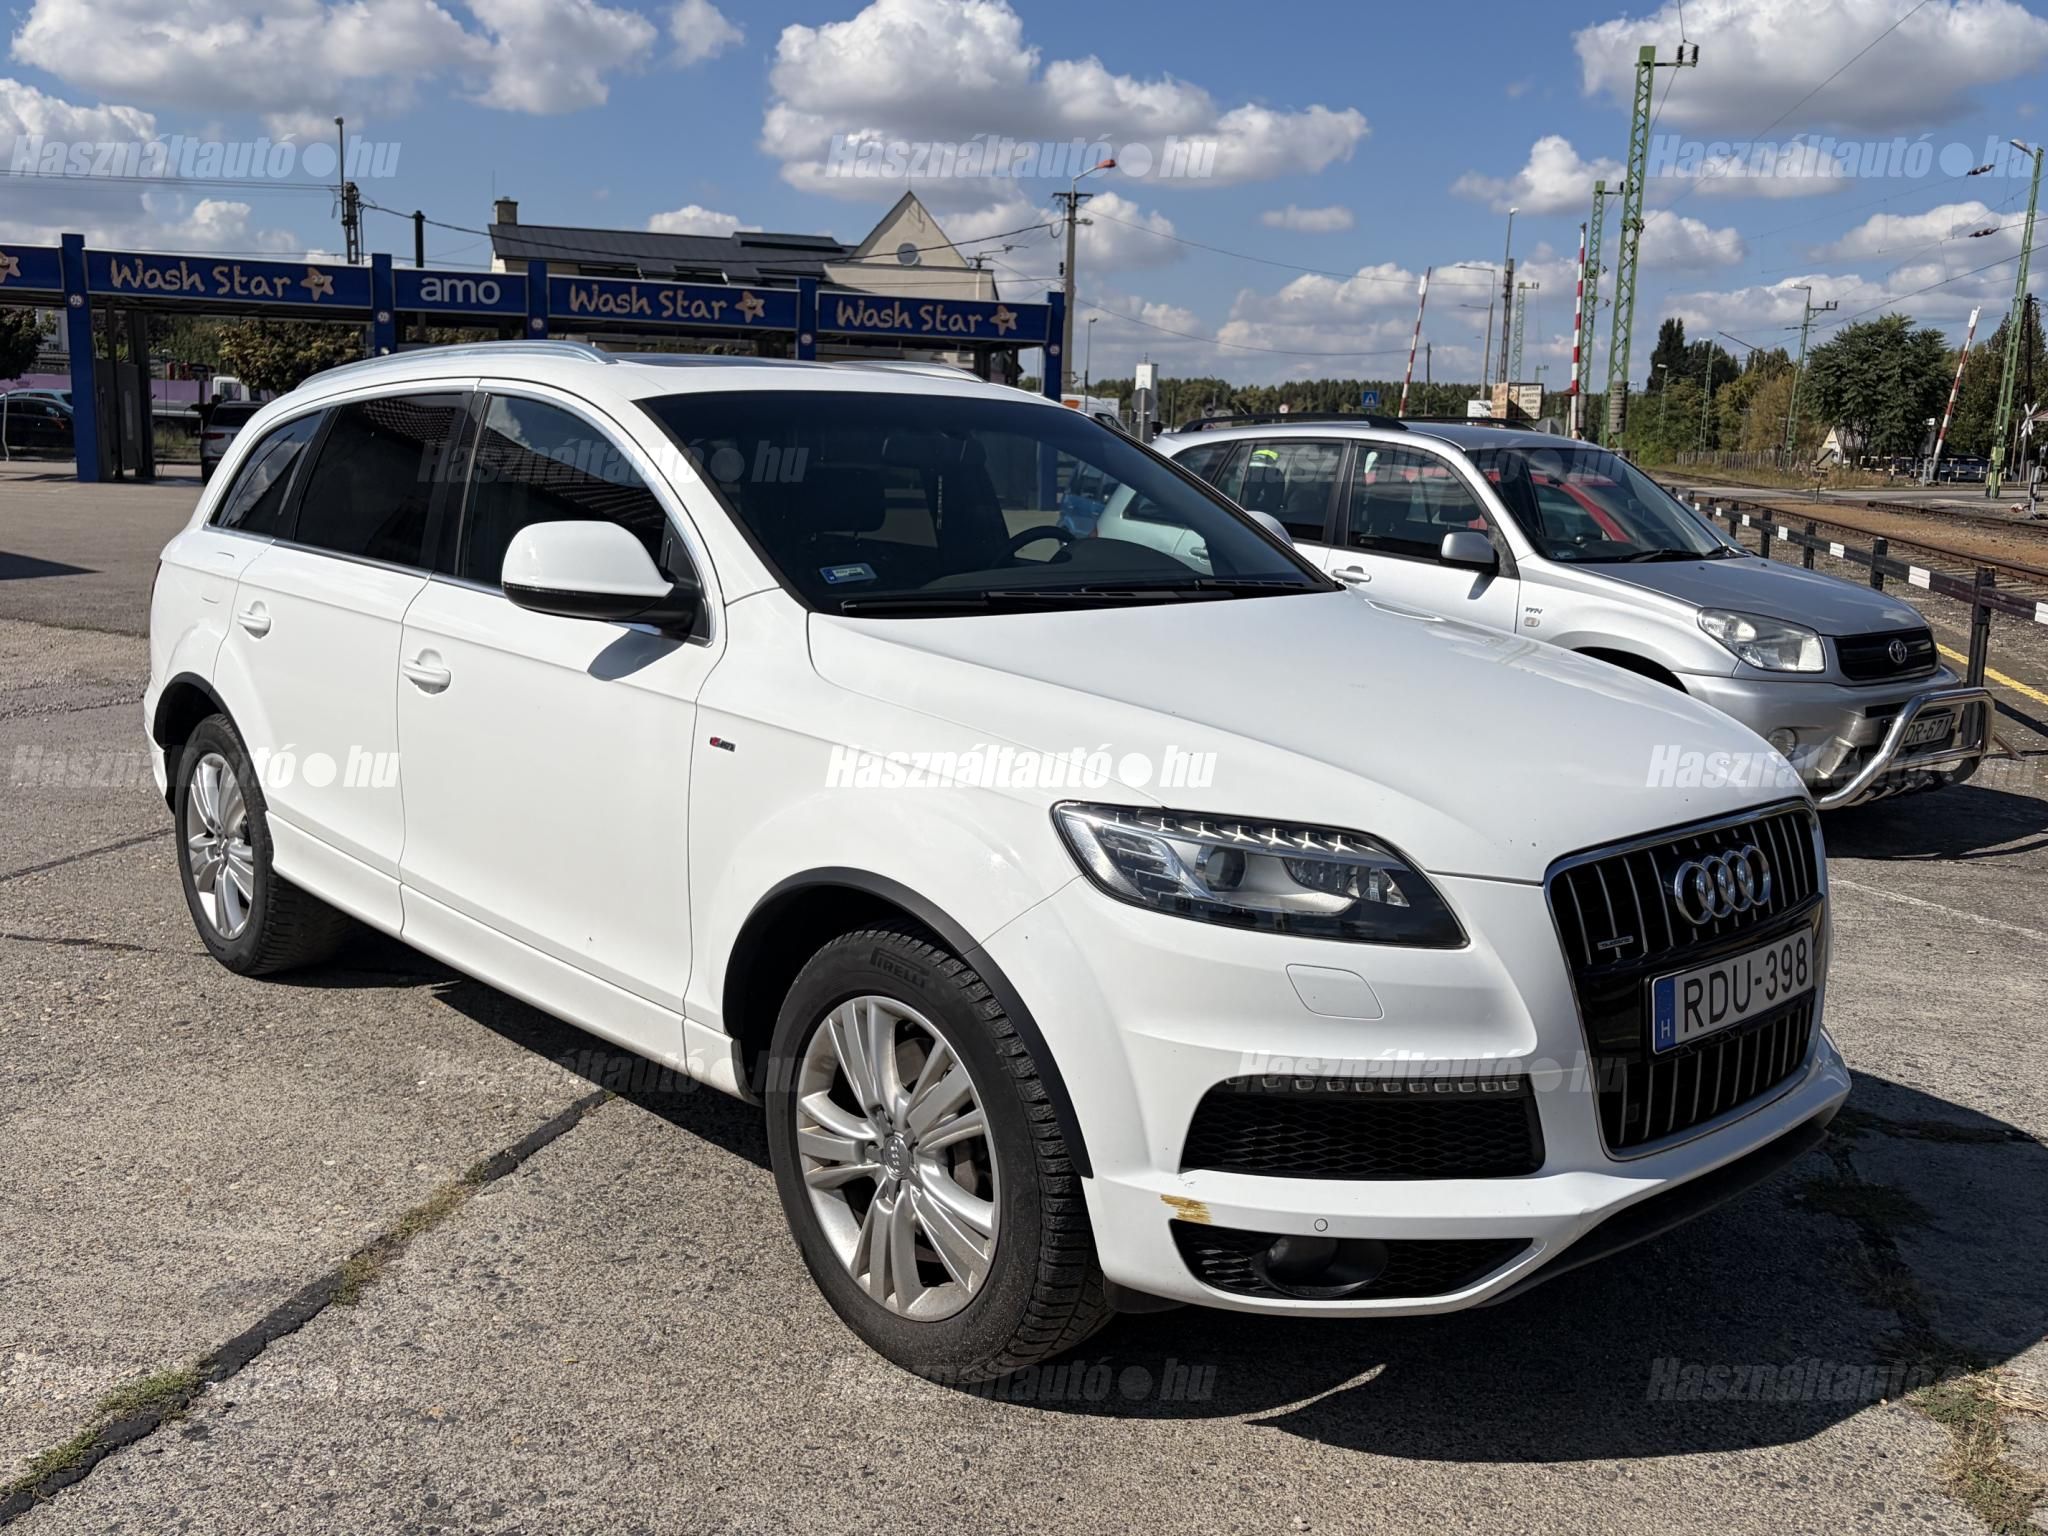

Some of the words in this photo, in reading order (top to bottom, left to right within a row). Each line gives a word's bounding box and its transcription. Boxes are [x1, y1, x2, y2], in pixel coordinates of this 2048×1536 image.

[110, 256, 205, 293] Wash
[212, 265, 292, 299] Star
[419, 276, 501, 305] amo
[569, 284, 652, 316] Wash
[658, 290, 728, 320] Star
[836, 300, 911, 329] Wash
[919, 306, 983, 334] Star
[870, 946, 930, 989] PIRELLI
[1683, 936, 1809, 1033] RDU-398
[1660, 1019, 1671, 1040] H
